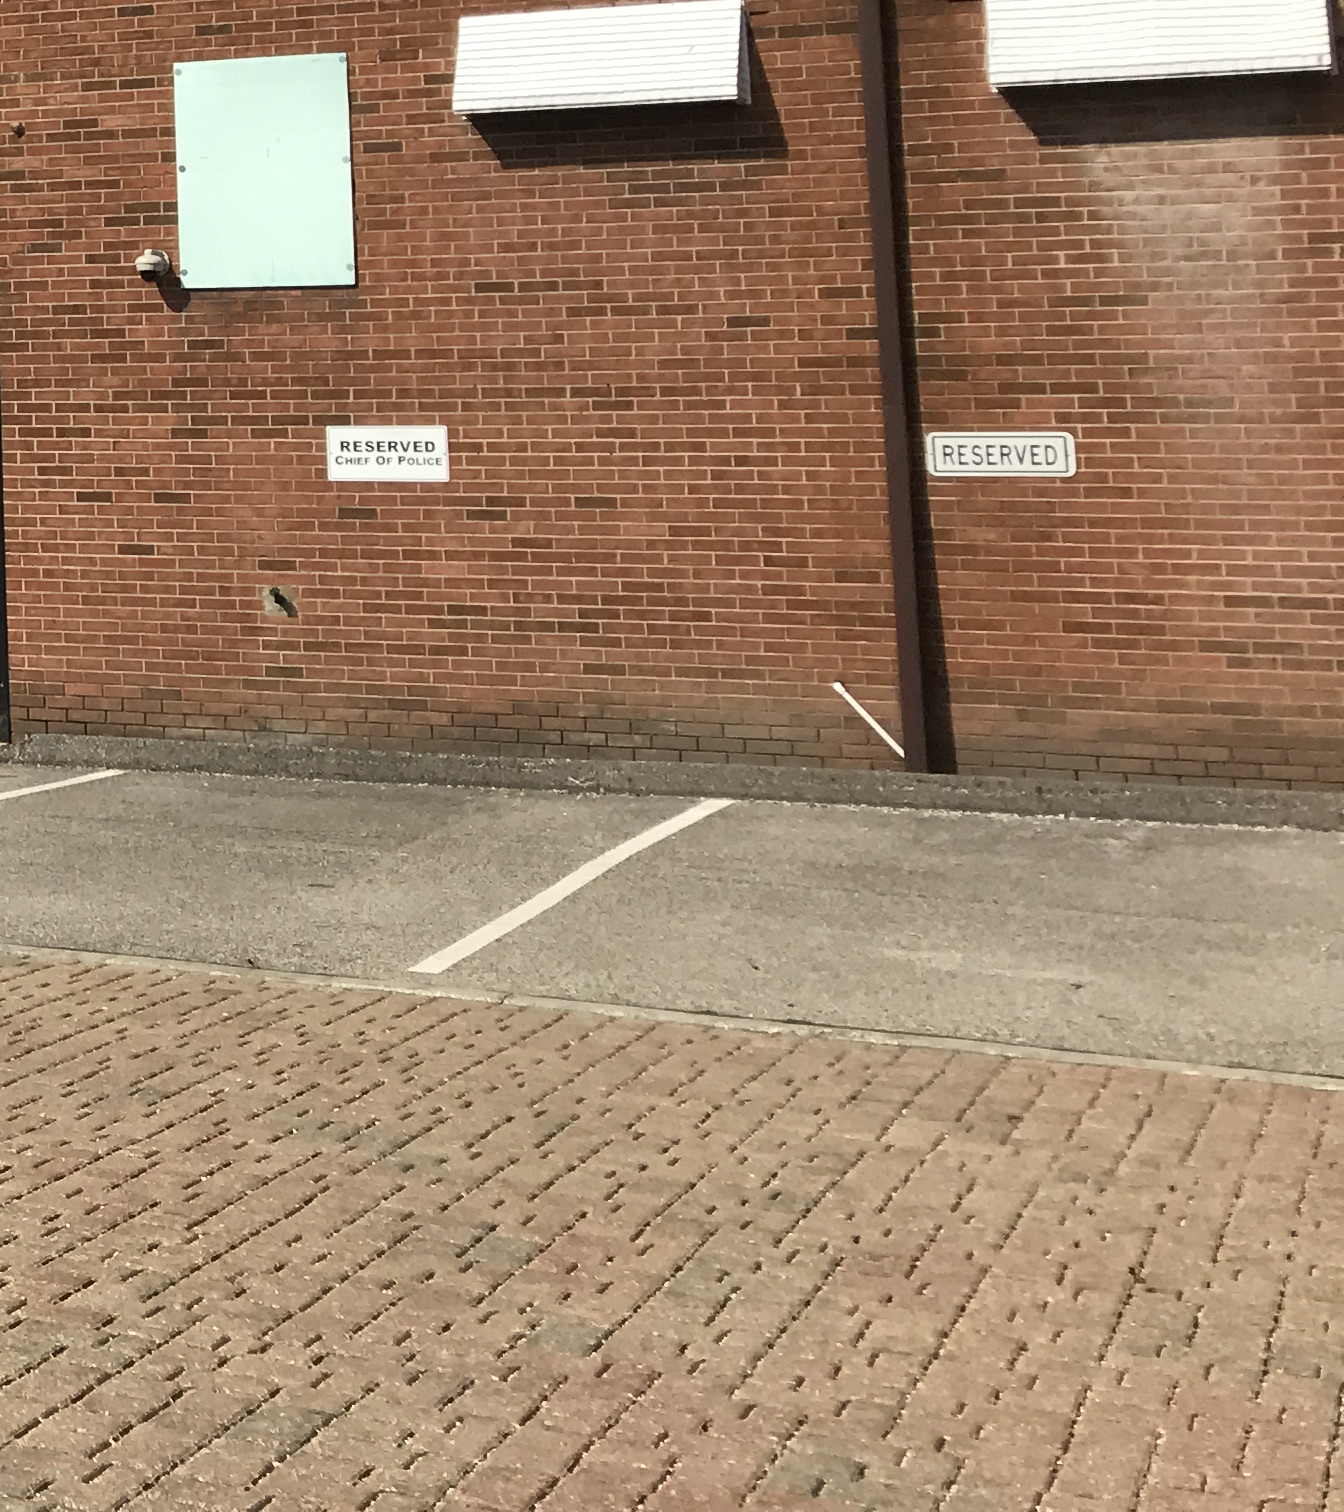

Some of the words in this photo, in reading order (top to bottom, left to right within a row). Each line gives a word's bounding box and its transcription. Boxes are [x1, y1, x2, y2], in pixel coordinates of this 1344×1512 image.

[340, 441, 435, 453] RESERVED
[335, 455, 370, 466] CHIEF
[376, 455, 393, 466] OF
[398, 455, 443, 466] POLICE
[942, 444, 1058, 466] RESERVED
